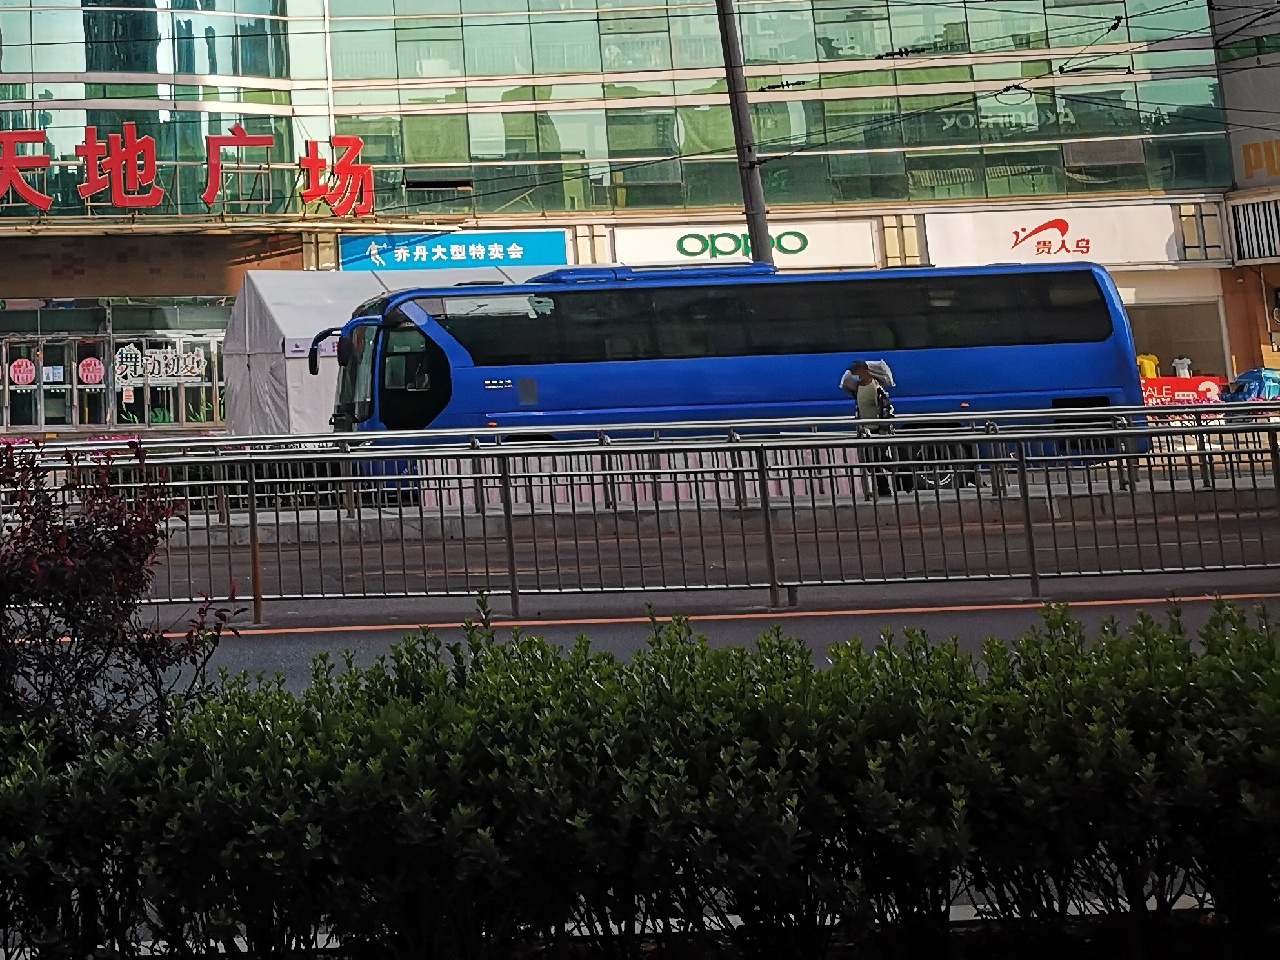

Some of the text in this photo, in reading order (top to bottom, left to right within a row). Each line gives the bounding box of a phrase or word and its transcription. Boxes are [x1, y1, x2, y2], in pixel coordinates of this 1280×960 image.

[942, 106, 1076, 132] YOSHINOYA
[393, 242, 525, 262] 乔丹大型特卖会
[1035, 238, 1090, 255] 贵人鸟
